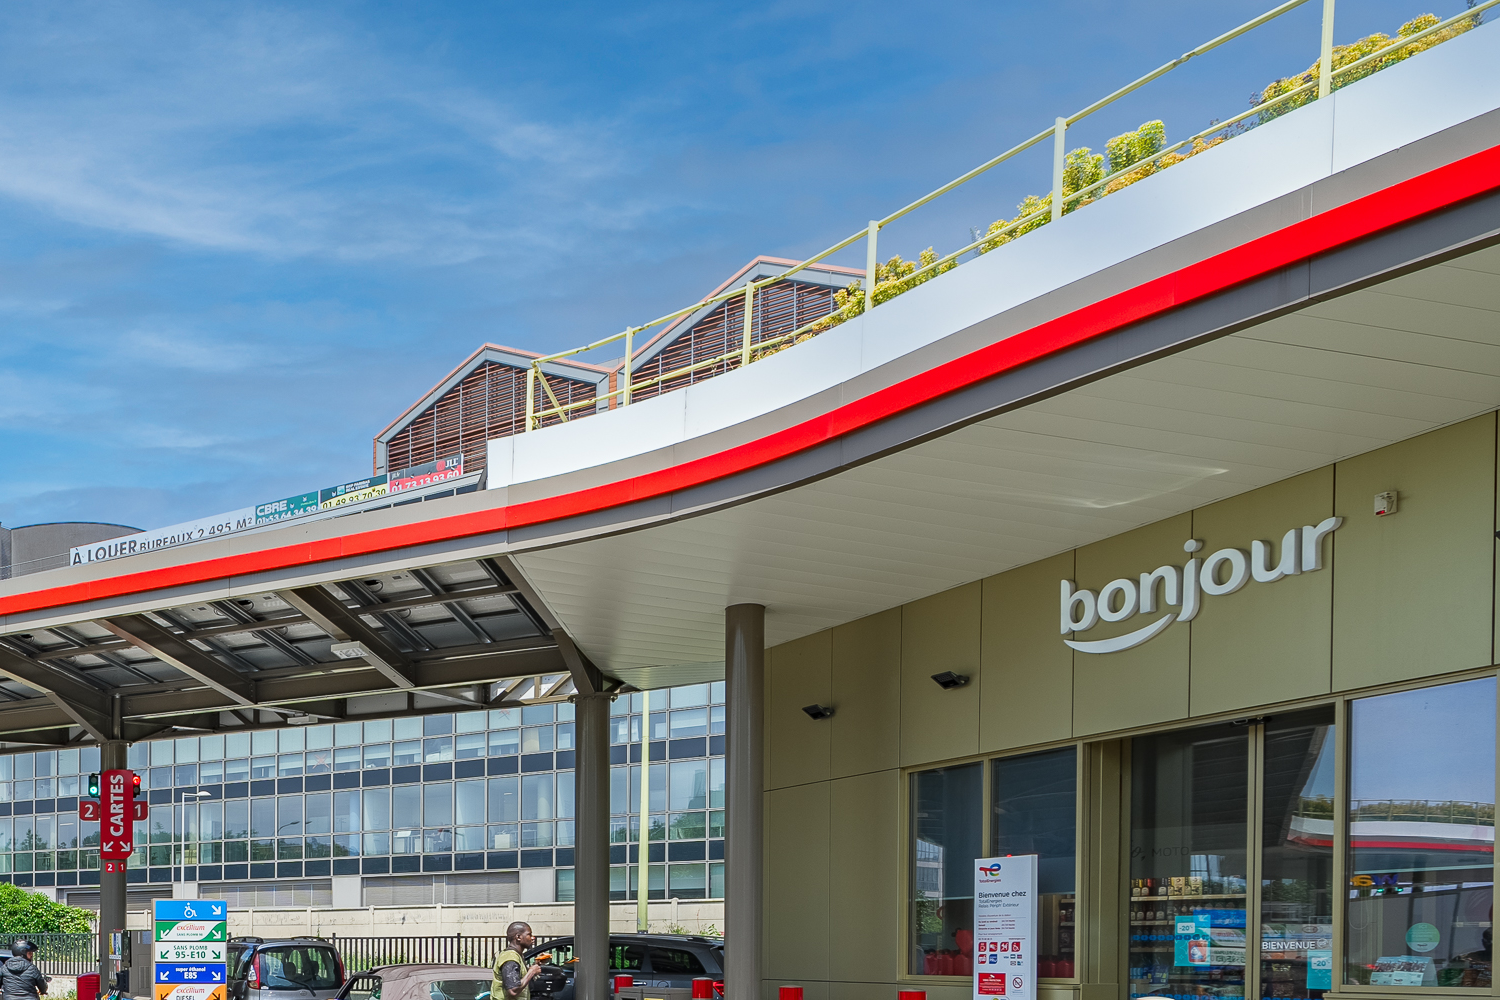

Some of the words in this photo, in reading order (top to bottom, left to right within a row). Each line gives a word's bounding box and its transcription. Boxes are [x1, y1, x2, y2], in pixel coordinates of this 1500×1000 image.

[257, 500, 288, 516] CBRE
[73, 548, 82, 565] À
[88, 540, 137, 562] LOUER
[140, 531, 193, 551] BUREAUX
[1060, 516, 1344, 635] bonjour
[84, 804, 94, 818] 2
[110, 774, 124, 837] CARTES
[134, 804, 142, 818] 1
[107, 863, 113, 871] 2
[120, 863, 124, 871] 1
[1262, 941, 1316, 950] BIENVENUE
[175, 951, 206, 959] 95-E10
